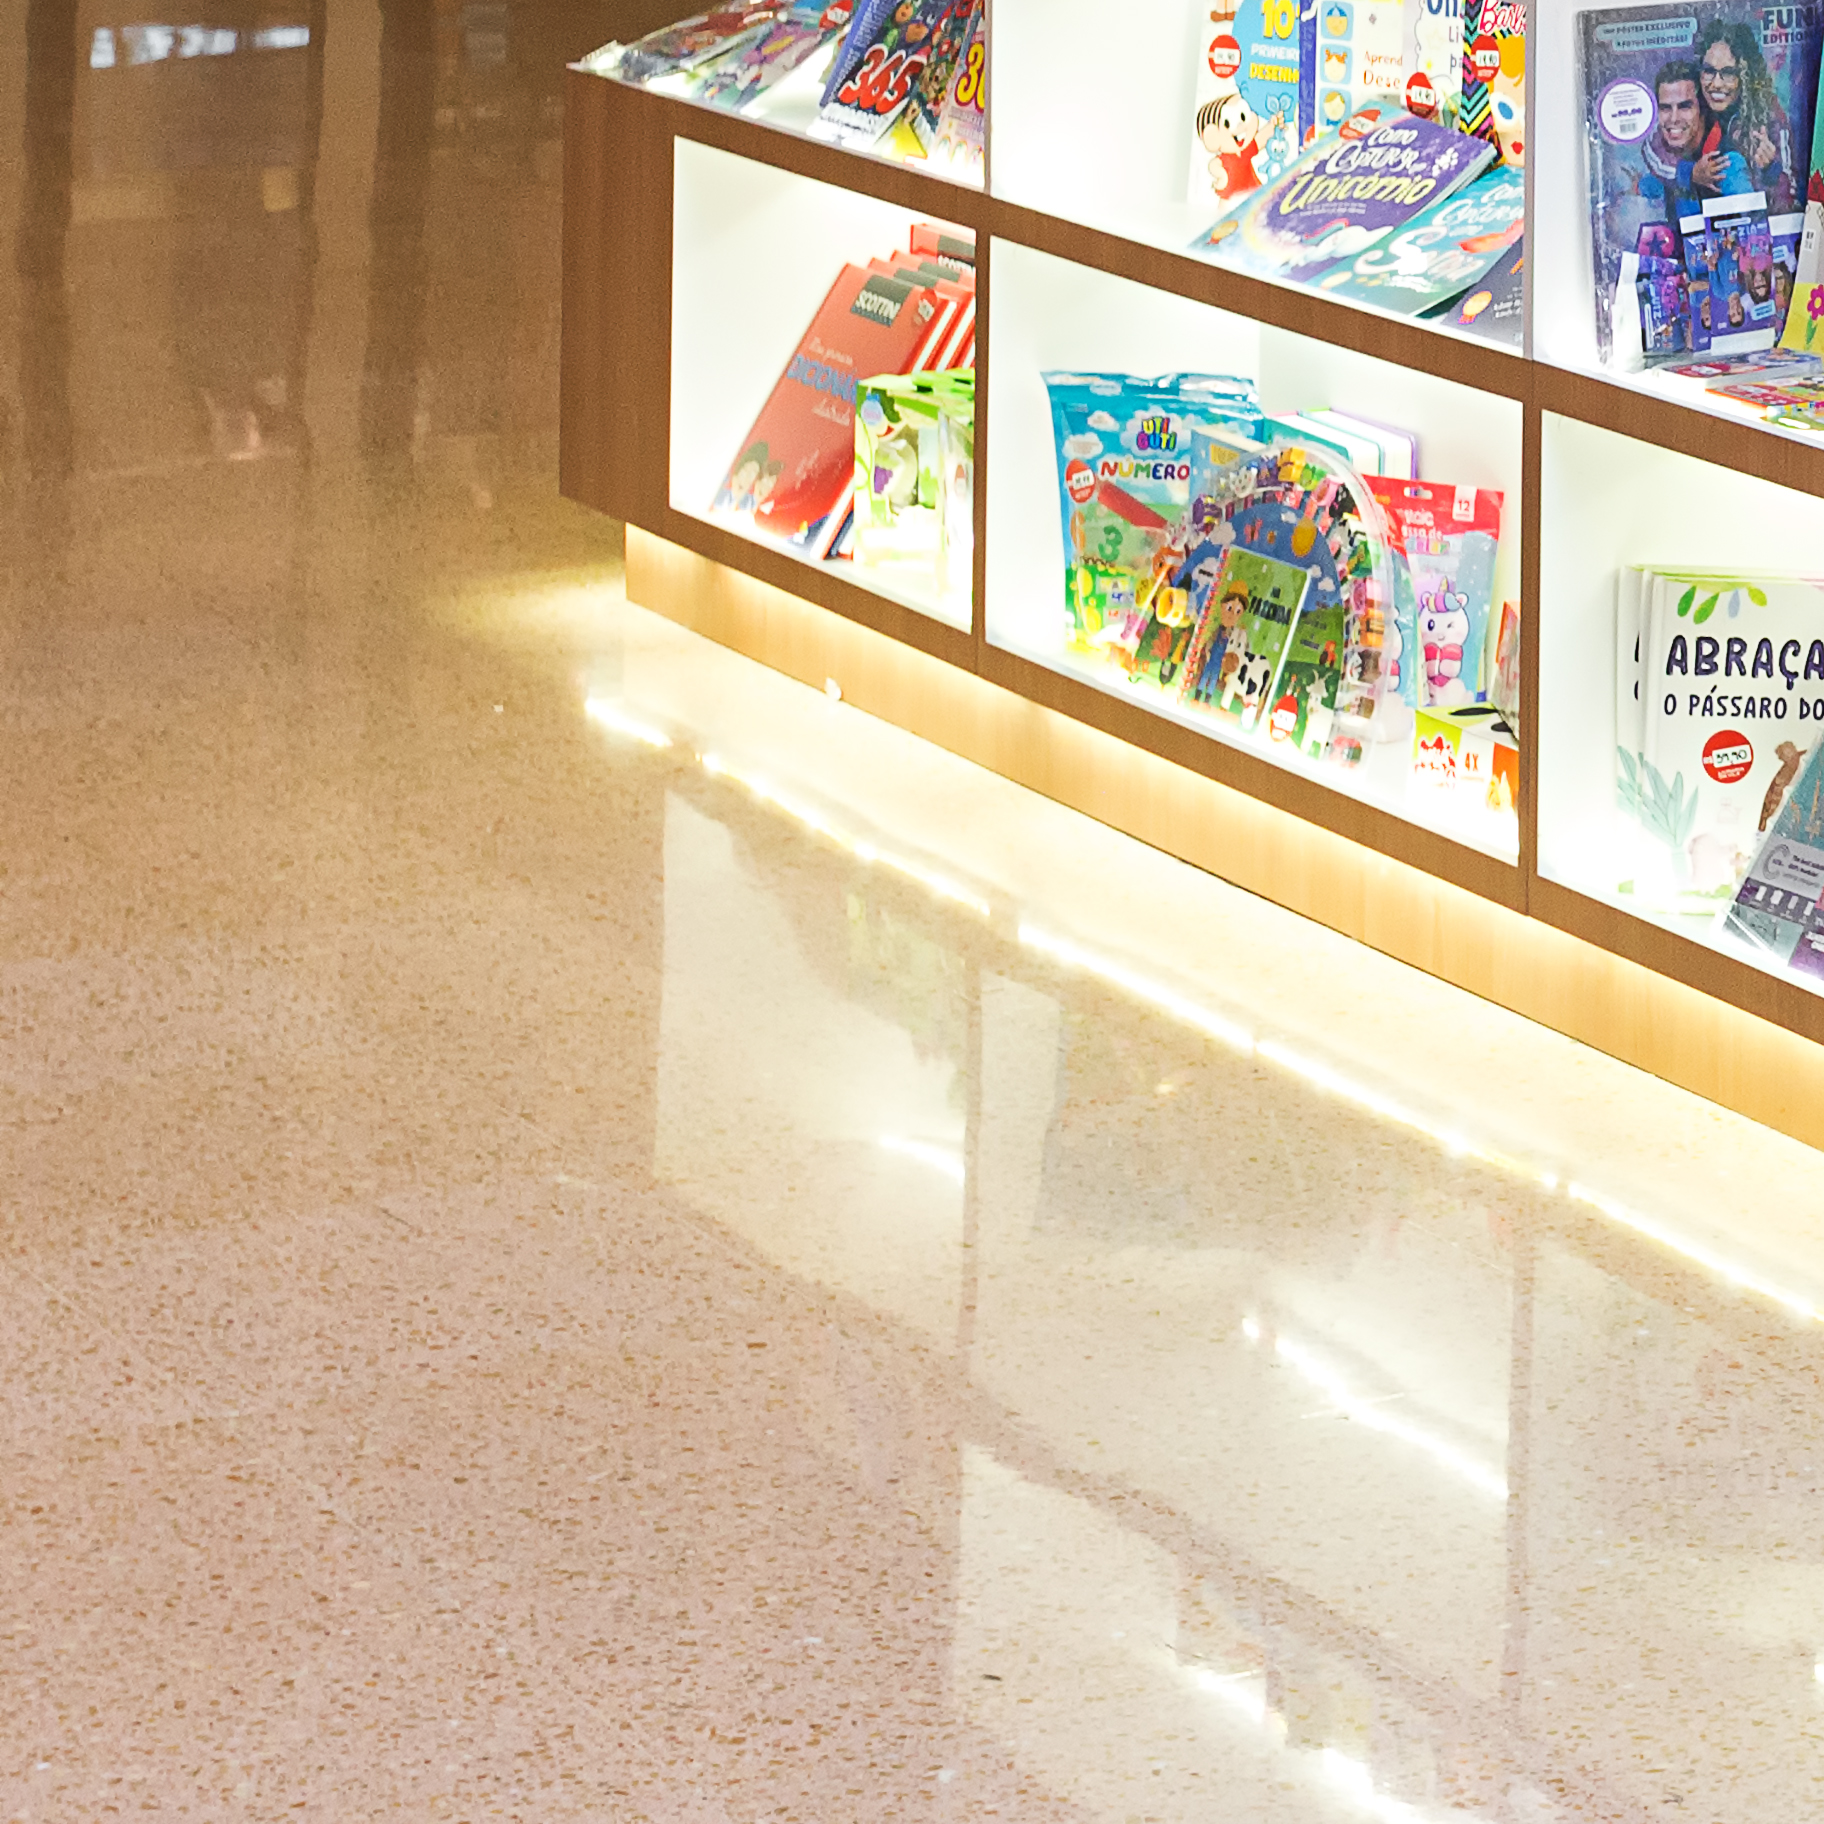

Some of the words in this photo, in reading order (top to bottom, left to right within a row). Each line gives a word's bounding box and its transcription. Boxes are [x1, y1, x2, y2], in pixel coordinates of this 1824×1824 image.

[839, 44, 928, 115] 365
[1280, 172, 1437, 215] Unicórnio
[1136, 428, 1176, 451] GUTI
[1142, 416, 1170, 437] UTI
[1457, 499, 1469, 512] 12
[1664, 693, 1677, 717] O
[1689, 685, 1788, 720] PÁSSARO
